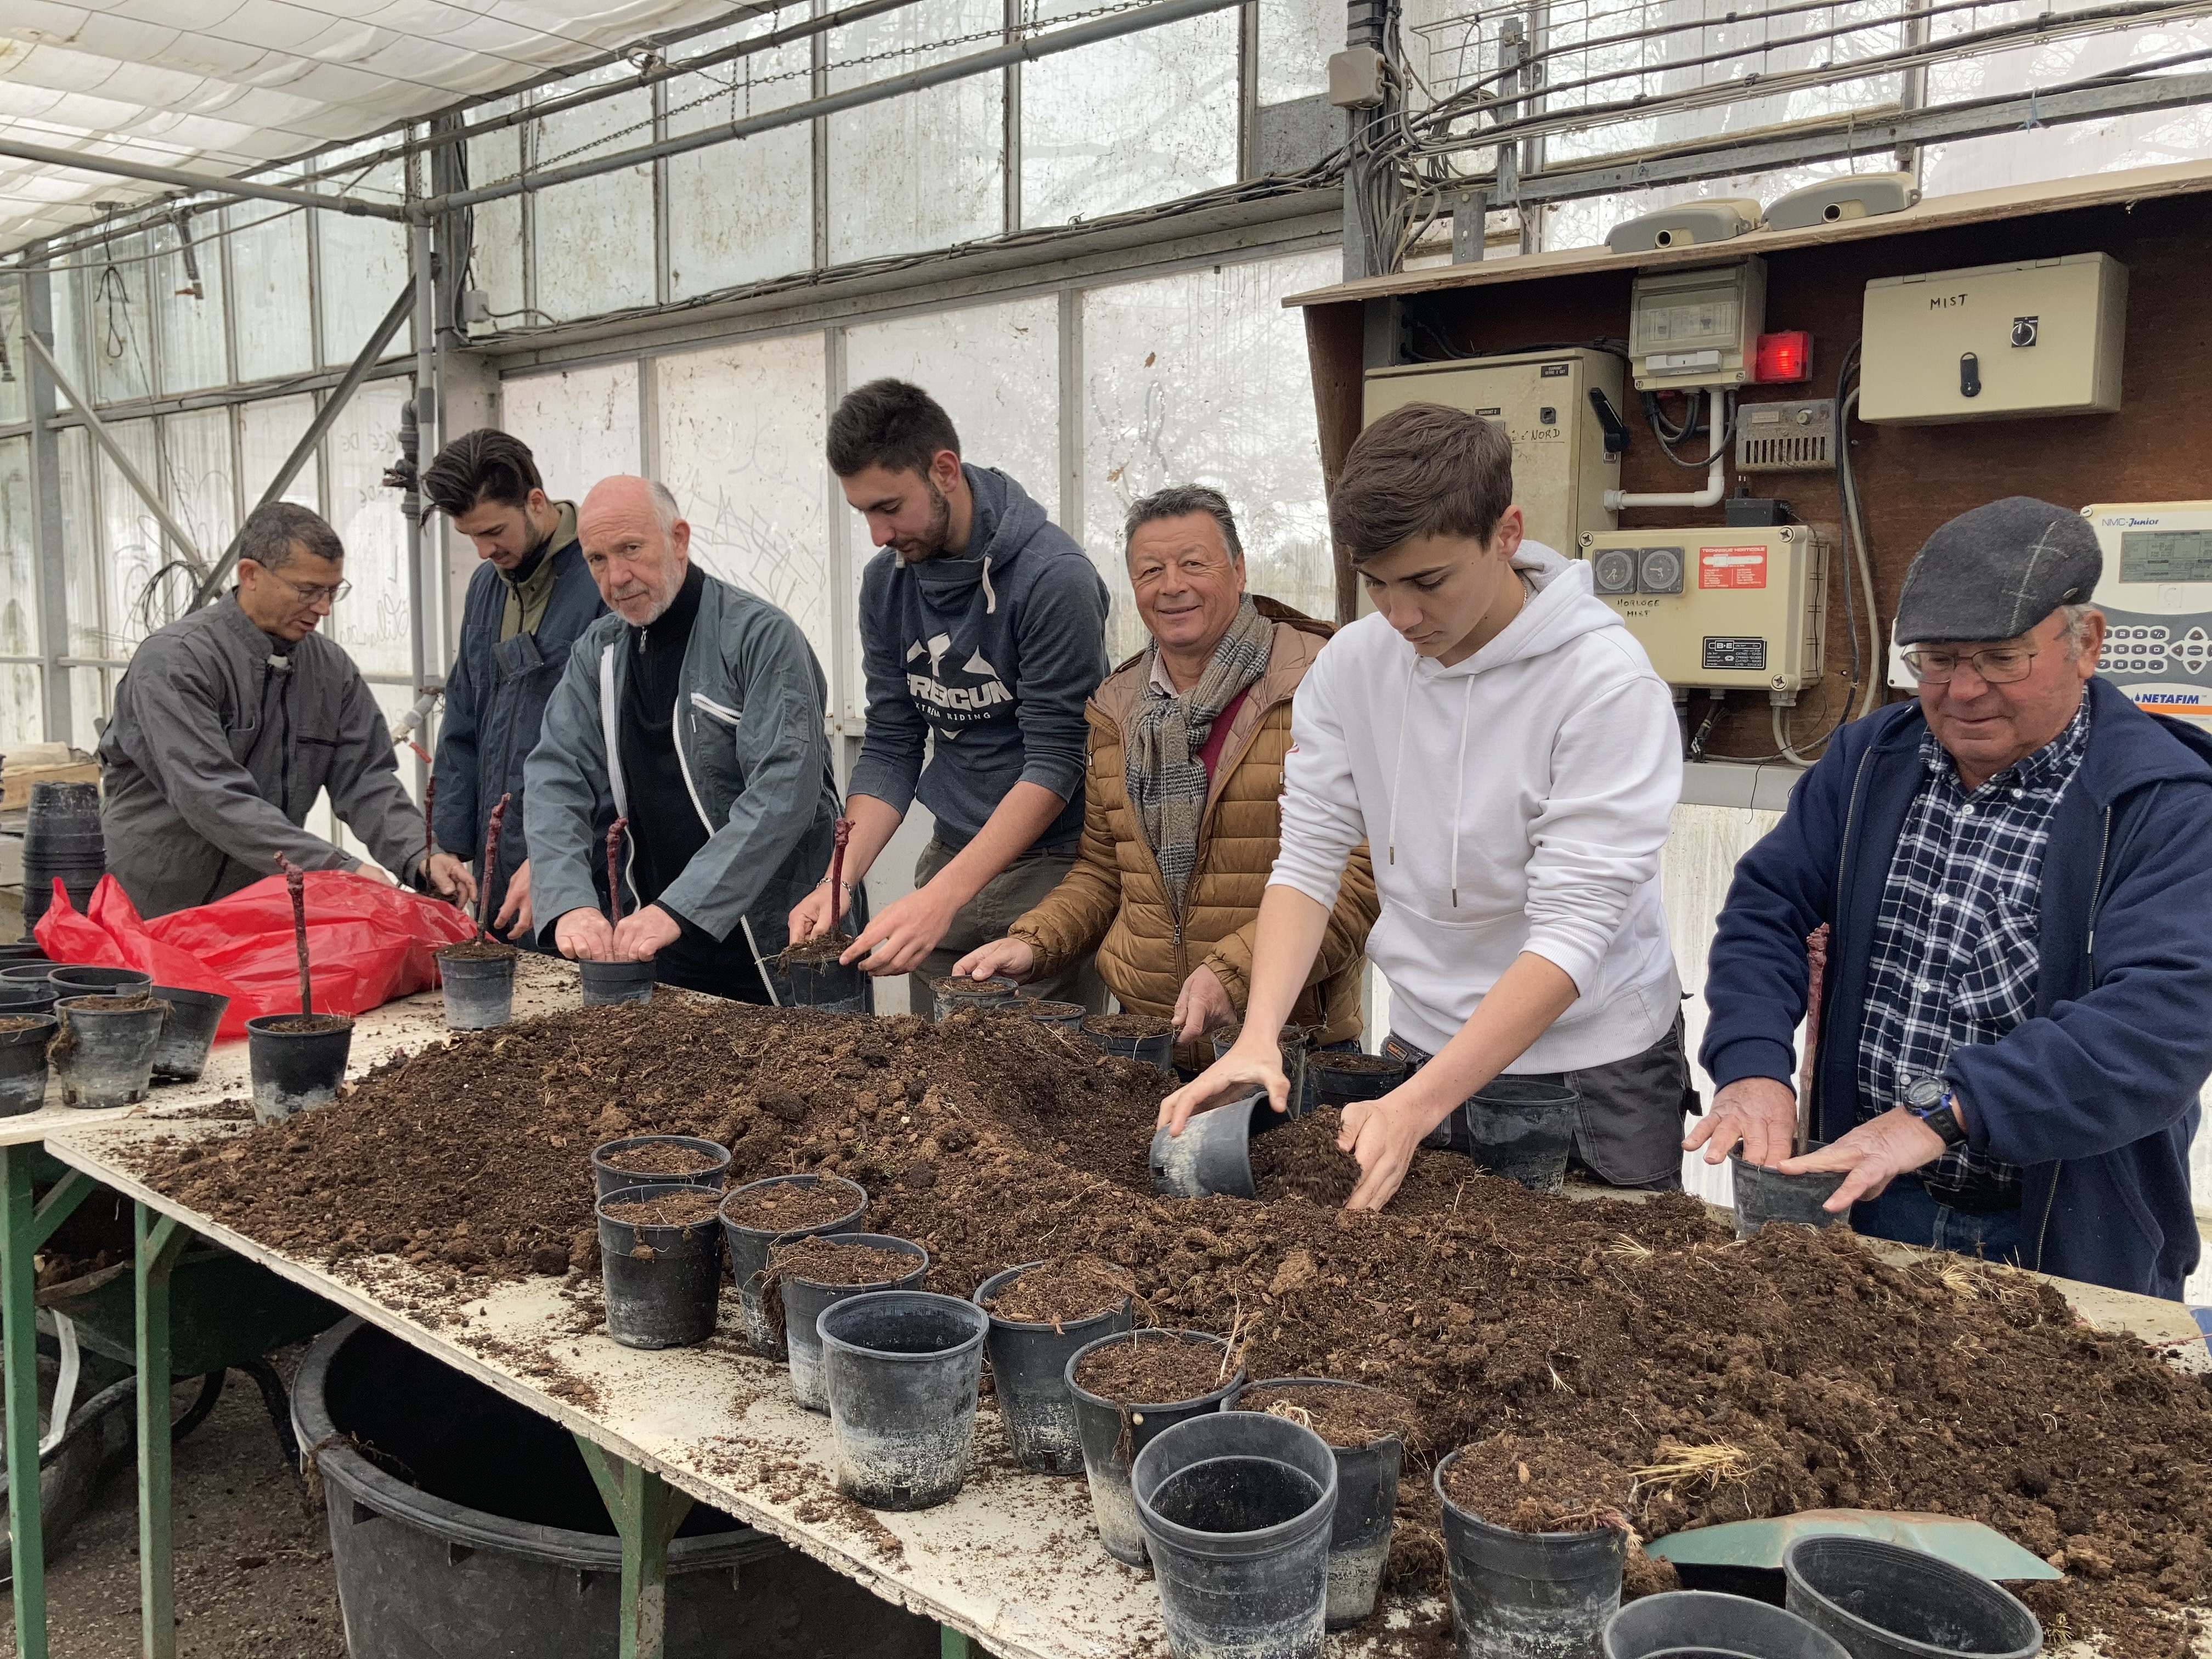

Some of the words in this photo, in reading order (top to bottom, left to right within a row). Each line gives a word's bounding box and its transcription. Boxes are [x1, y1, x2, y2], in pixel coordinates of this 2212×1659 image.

[1930, 294, 1968, 311] MIST
[1531, 428, 1560, 441] NORD
[1617, 599, 1660, 607] HORLOGE
[2142, 693, 2199, 704] NETAFIM
[915, 701, 940, 718] XTREM
[947, 712, 991, 721] RIDING
